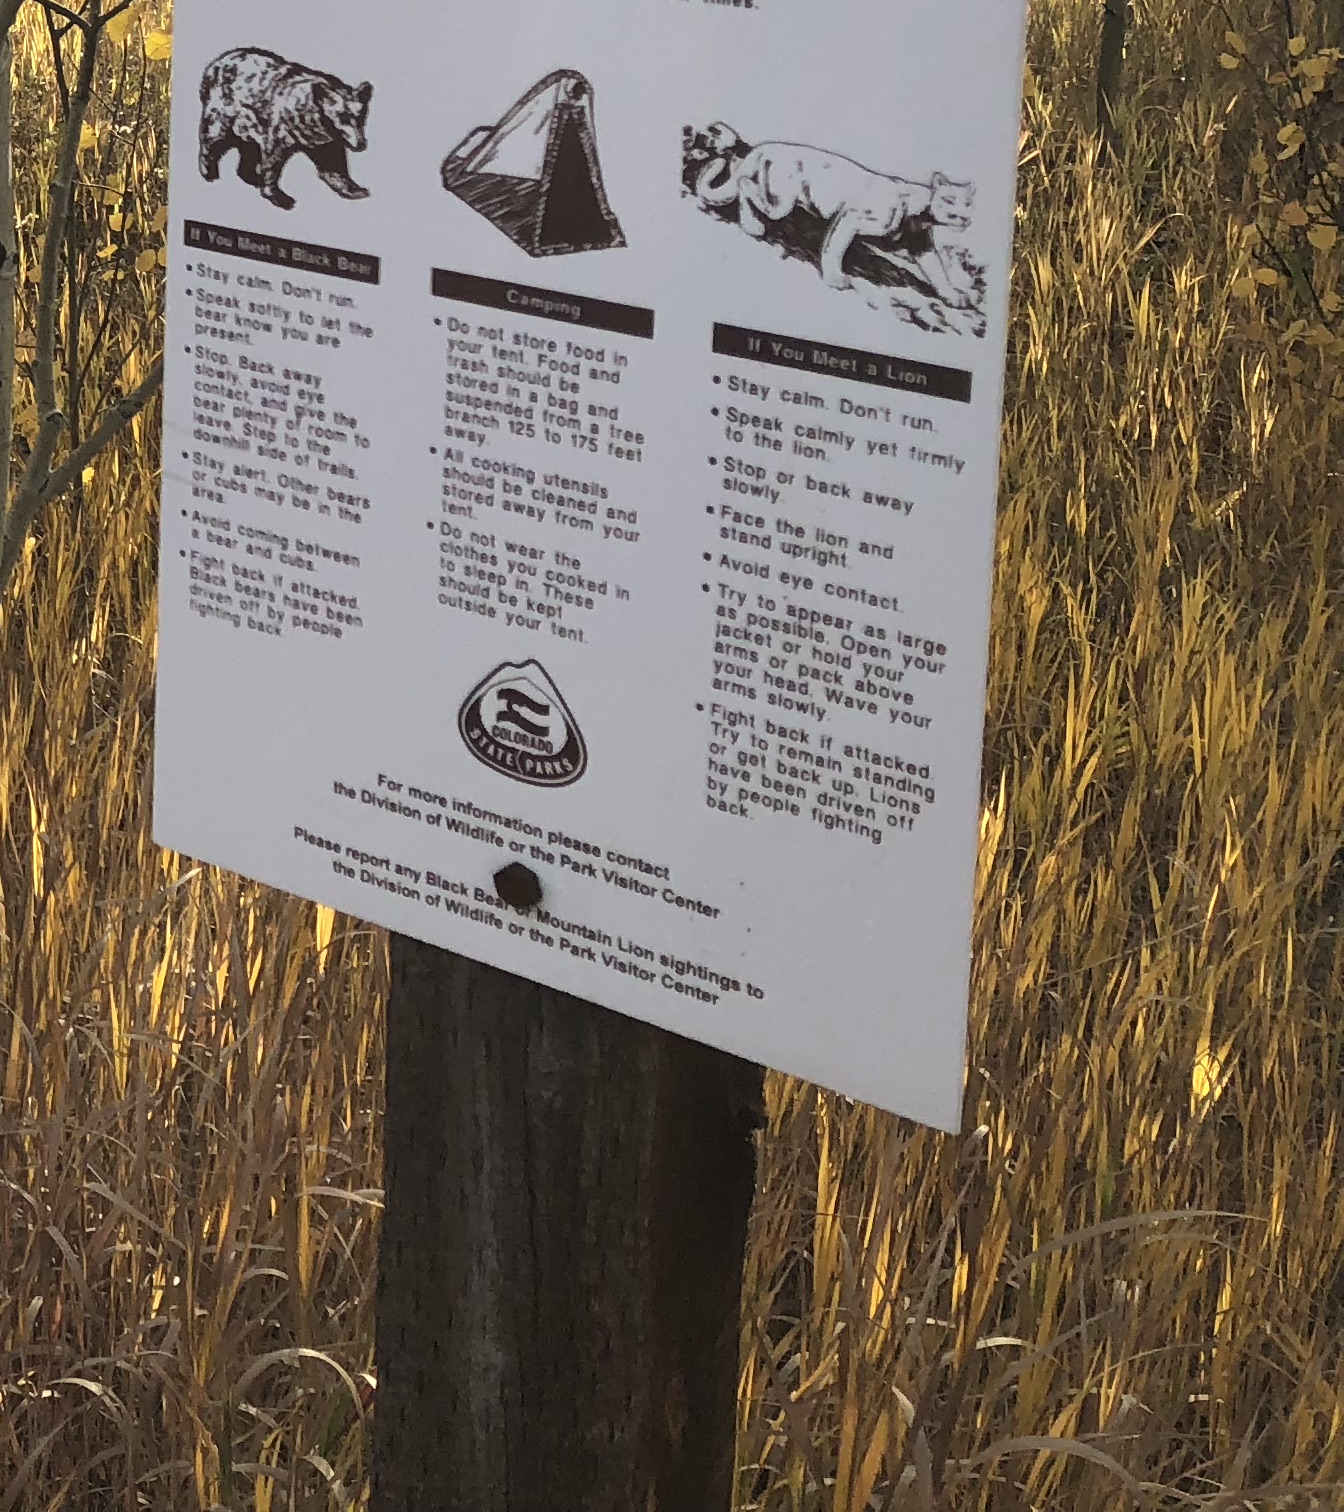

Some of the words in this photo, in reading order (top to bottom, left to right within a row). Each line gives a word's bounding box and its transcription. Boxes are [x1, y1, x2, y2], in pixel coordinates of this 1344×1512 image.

[506, 289, 580, 319] Camping
[447, 318, 470, 335] Do
[477, 326, 504, 342] not
[512, 332, 557, 353] store
[566, 341, 605, 363] food
[613, 351, 628, 367] in
[748, 337, 760, 352] If
[771, 342, 804, 361] You
[813, 350, 856, 371] Meet
[867, 364, 877, 375] a
[886, 365, 926, 385] Lion
[725, 407, 783, 432] Speak
[794, 424, 855, 450] calmly
[867, 440, 898, 457] yet
[728, 376, 770, 400] Stay
[780, 389, 829, 409] calm.
[839, 398, 891, 422] Don't
[901, 414, 937, 433] run.
[725, 426, 743, 443] to
[753, 432, 782, 451] the
[724, 457, 766, 481] Stop
[776, 471, 795, 485] or
[805, 475, 851, 499] back
[862, 491, 914, 514] away
[719, 505, 765, 529] Face
[775, 518, 806, 539] the
[815, 527, 849, 548] lion
[858, 541, 894, 559] and
[720, 526, 771, 550] stand
[438, 593, 497, 618] outside
[505, 612, 541, 630] your
[718, 554, 770, 579] Avoid
[778, 571, 814, 590] eye
[823, 583, 903, 613] contact.
[716, 605, 737, 620] as
[745, 612, 829, 645] possible.
[840, 634, 891, 661] Open
[902, 654, 946, 674] your
[718, 585, 747, 607] Try
[757, 595, 776, 611] to
[786, 604, 853, 632] appear
[861, 625, 887, 640] as
[897, 630, 947, 656] large
[714, 641, 759, 663] arms
[768, 655, 788, 670] or
[797, 663, 844, 686] pack
[854, 677, 914, 705] above
[715, 621, 772, 648] jacket
[781, 641, 802, 655] or
[811, 645, 852, 670] hold
[862, 662, 904, 683] your
[711, 677, 757, 700] arms
[713, 659, 753, 679] your
[762, 670, 813, 697] head.
[823, 686, 878, 715] Wave
[889, 708, 932, 729] your
[469, 727, 515, 767] STATE
[525, 758, 574, 775] PARKS
[491, 724, 554, 754] COLORADO
[710, 704, 755, 729] Fight
[764, 719, 809, 745] back
[820, 735, 833, 751] if
[708, 742, 727, 756] or
[737, 750, 766, 769] get
[776, 759, 821, 785] back
[831, 779, 859, 798] up.
[870, 787, 920, 815] Lions
[711, 722, 740, 745] Try
[750, 733, 769, 751] to
[778, 744, 842, 773] remain
[853, 765, 935, 802] standing
[706, 794, 753, 820] back.
[706, 776, 728, 797] by
[737, 787, 800, 816] people
[811, 807, 882, 843] fighting
[708, 758, 751, 783] have
[761, 773, 806, 799] been
[816, 791, 876, 821] driven
[887, 814, 914, 831] off
[333, 781, 356, 799] the
[361, 788, 421, 821] Division
[425, 813, 442, 827] of
[445, 816, 504, 848] Wildlife
[508, 840, 526, 854] or
[529, 845, 555, 865] the
[560, 853, 597, 879] Park
[601, 867, 658, 898] Visitor
[661, 888, 721, 919] Center
[377, 773, 404, 793] For
[408, 786, 448, 808] more
[452, 797, 543, 839] information
[547, 831, 601, 857] please
[606, 850, 670, 881] contact
[294, 825, 341, 854] Please
[345, 847, 390, 871] report
[394, 863, 421, 884] any
[425, 871, 469, 897] Black
[537, 908, 612, 947] Mountain
[617, 936, 654, 962] Lion
[659, 953, 741, 992] sightings
[746, 982, 765, 1000] to
[332, 859, 355, 879] the
[359, 869, 421, 901] Division
[425, 894, 441, 908] of
[444, 897, 503, 929] Wildlife
[508, 922, 525, 936] or
[529, 927, 554, 947] the
[559, 936, 596, 963] Park
[601, 951, 656, 983] Visitor
[661, 972, 720, 1005] Center
